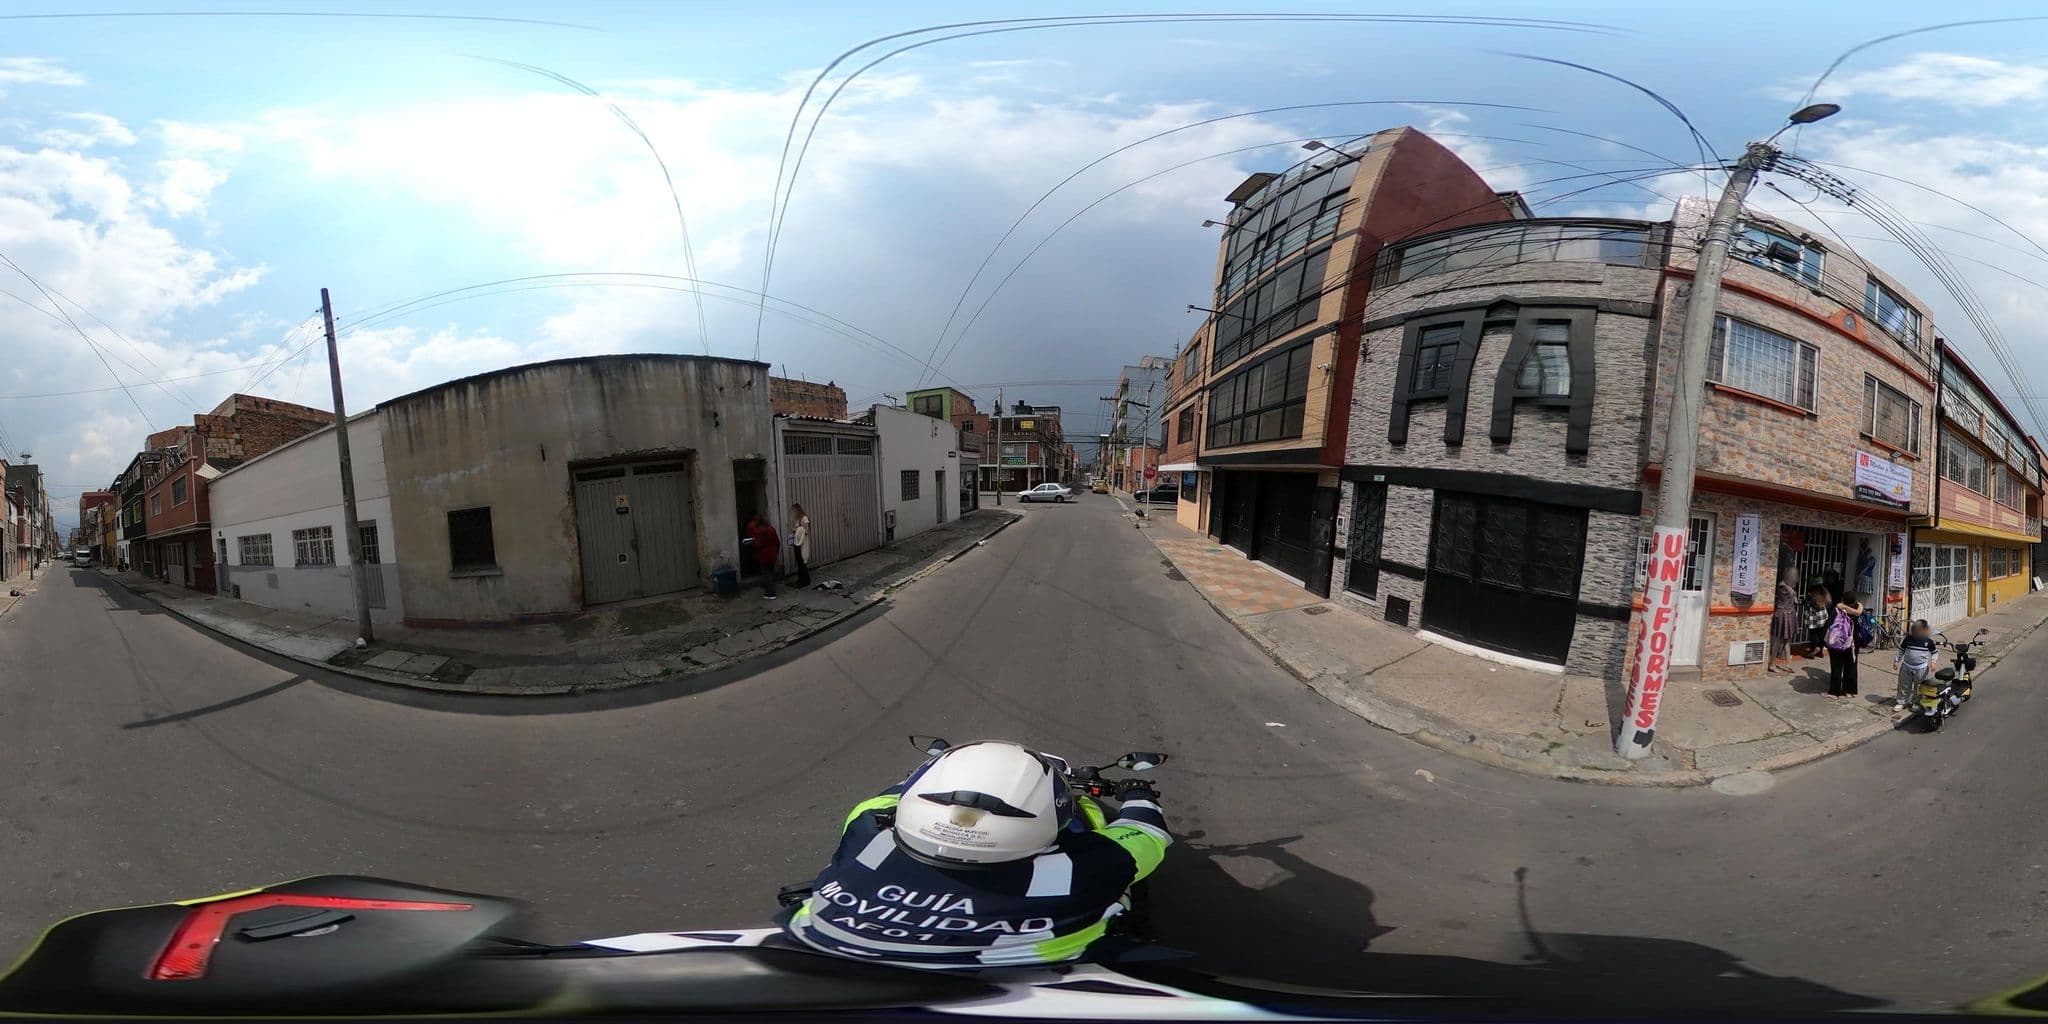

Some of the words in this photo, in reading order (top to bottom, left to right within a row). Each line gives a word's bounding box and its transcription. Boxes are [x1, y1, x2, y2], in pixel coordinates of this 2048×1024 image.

[1738, 519, 1751, 587] UNIFORMES
[1635, 533, 1683, 728] UNIFORMES
[820, 881, 1054, 933] MOVILIDAD
[877, 884, 975, 915] GUÍA
[832, 916, 935, 941] AF01
